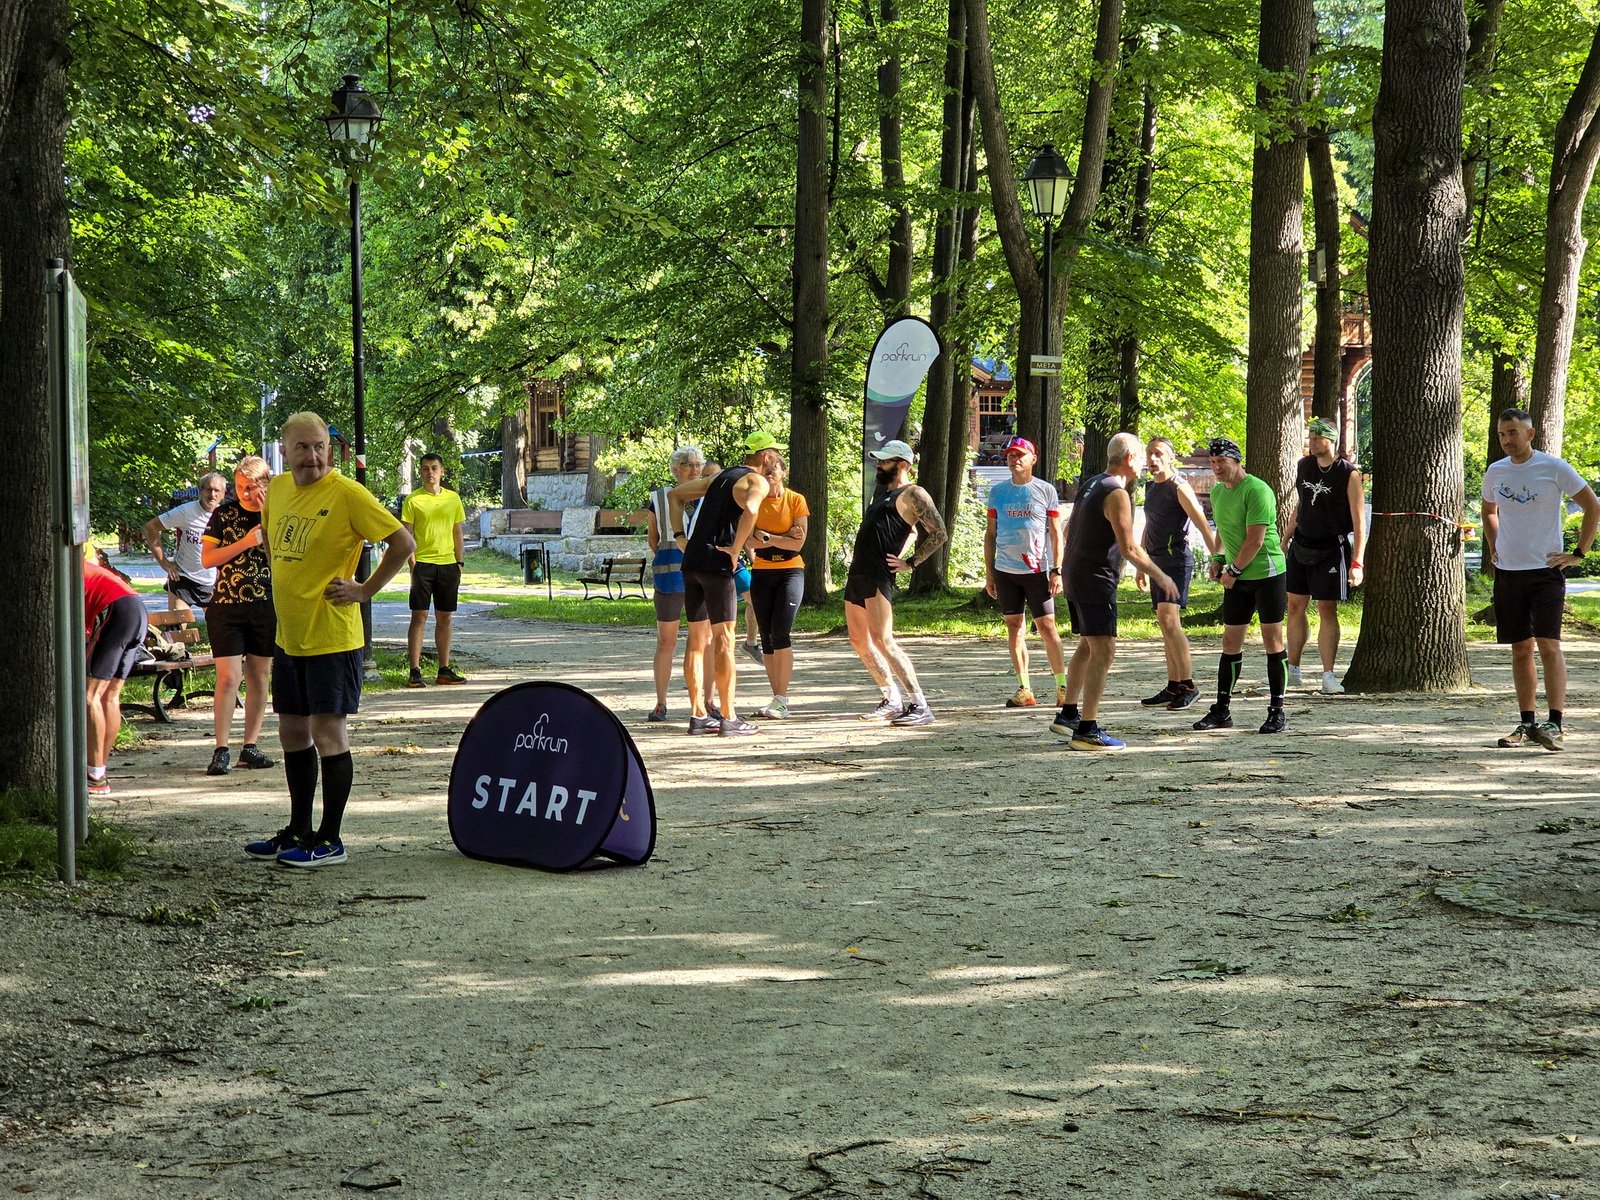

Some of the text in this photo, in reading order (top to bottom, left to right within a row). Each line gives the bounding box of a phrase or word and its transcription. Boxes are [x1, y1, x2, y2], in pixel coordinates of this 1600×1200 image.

[880, 344, 927, 363] parkrun
[1007, 510, 1032, 518] TEAM
[273, 515, 317, 553] 10K
[284, 525, 294, 544] you
[513, 714, 568, 754] parkrun
[471, 774, 598, 826] START
